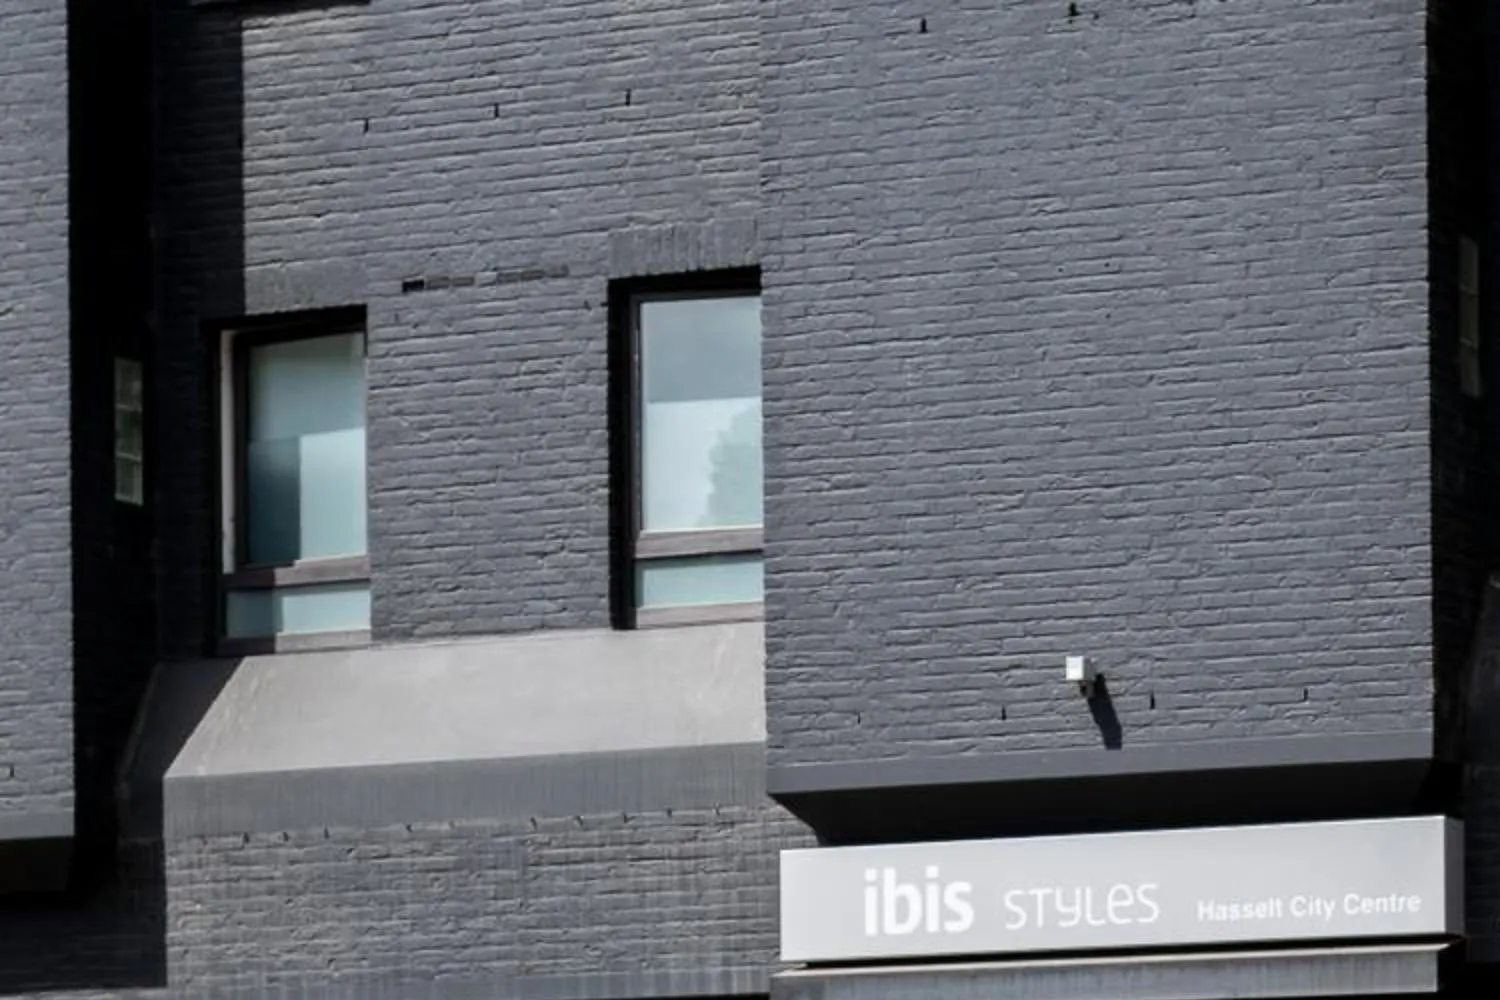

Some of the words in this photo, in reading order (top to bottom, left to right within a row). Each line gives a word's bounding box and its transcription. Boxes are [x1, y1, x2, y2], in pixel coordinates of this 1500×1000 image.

[864, 865, 975, 936] ibis
[1197, 897, 1283, 922] Hasselt
[1289, 896, 1336, 922] City
[1343, 893, 1422, 916] Centre
